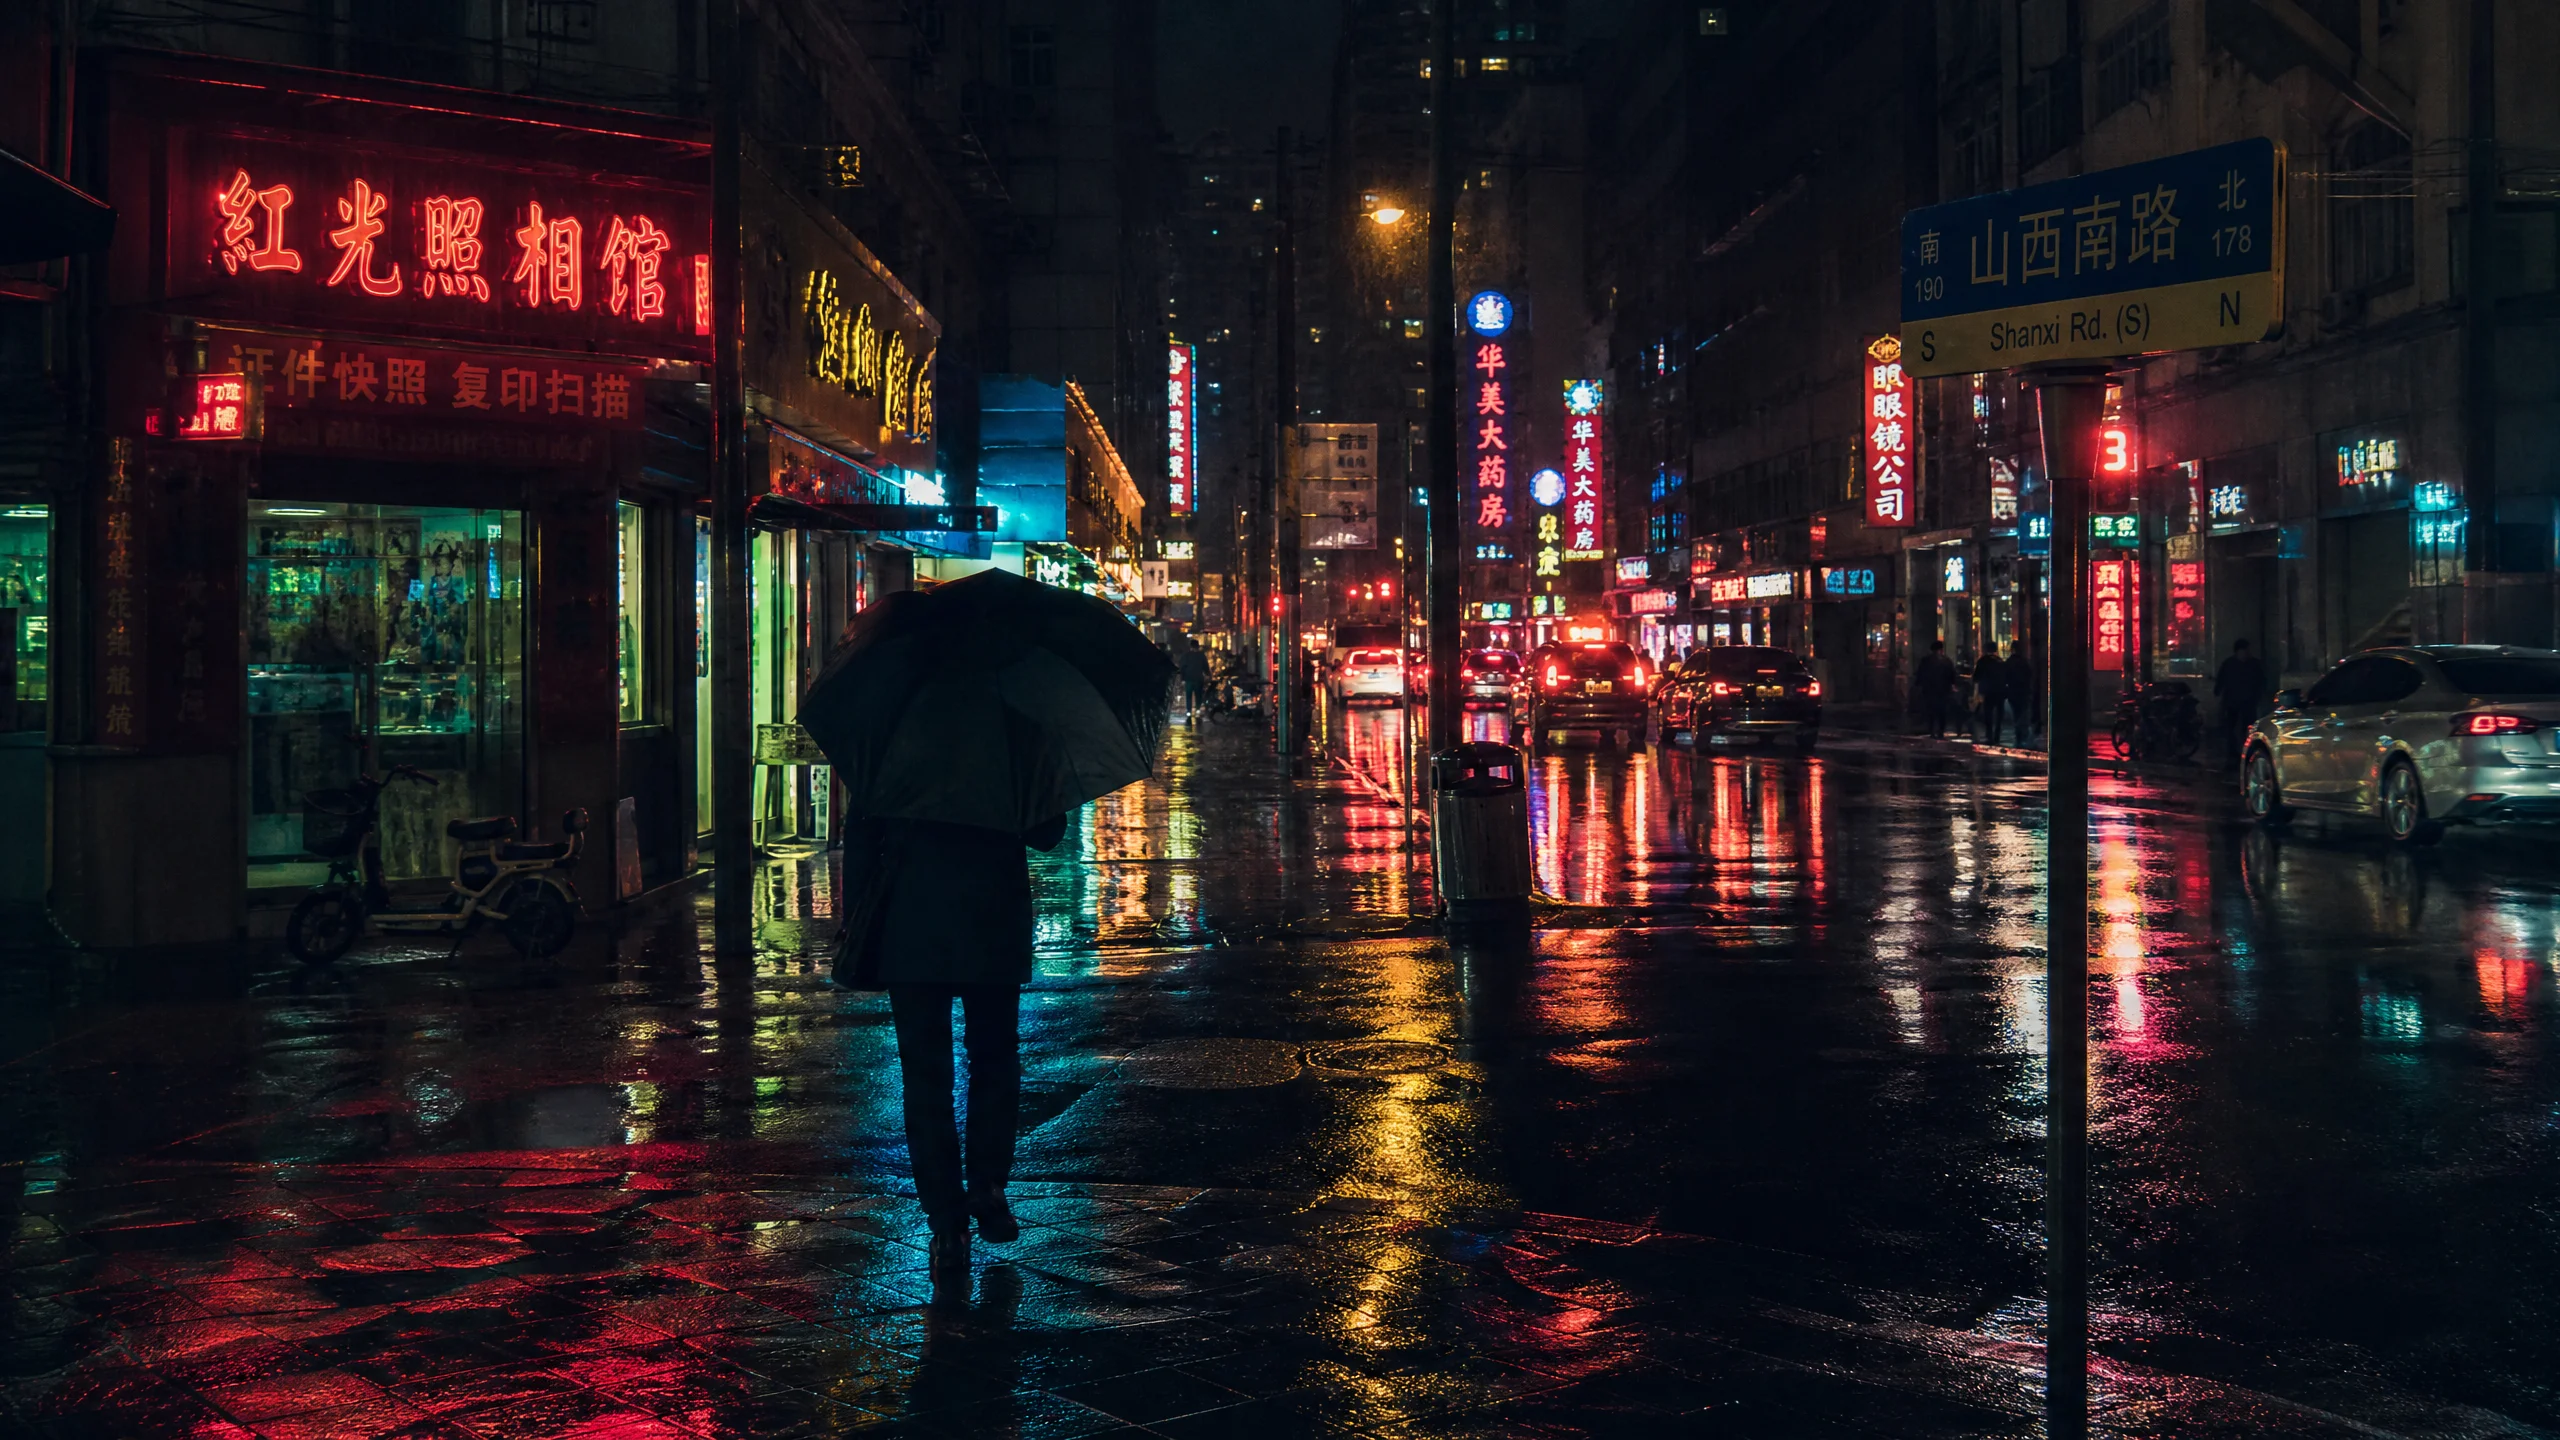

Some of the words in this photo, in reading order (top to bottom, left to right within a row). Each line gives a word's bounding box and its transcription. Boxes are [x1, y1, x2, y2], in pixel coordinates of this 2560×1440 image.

[2218, 169, 2247, 212] 北
[1919, 228, 1941, 266] 南
[1971, 183, 2182, 288] 山西南路
[2211, 224, 2253, 259] 178
[1914, 275, 1944, 303] 190
[2219, 290, 2241, 328] N
[1921, 330, 1936, 363] S
[1990, 315, 2060, 352] Shanxi
[2070, 310, 2108, 344] Rd.
[2116, 303, 2151, 344] (S)
[451, 360, 632, 420] 复印扫描
[1475, 343, 1508, 528] 华美大药房
[2103, 430, 2127, 471] 3
[1572, 420, 1597, 550] 华美大药房
